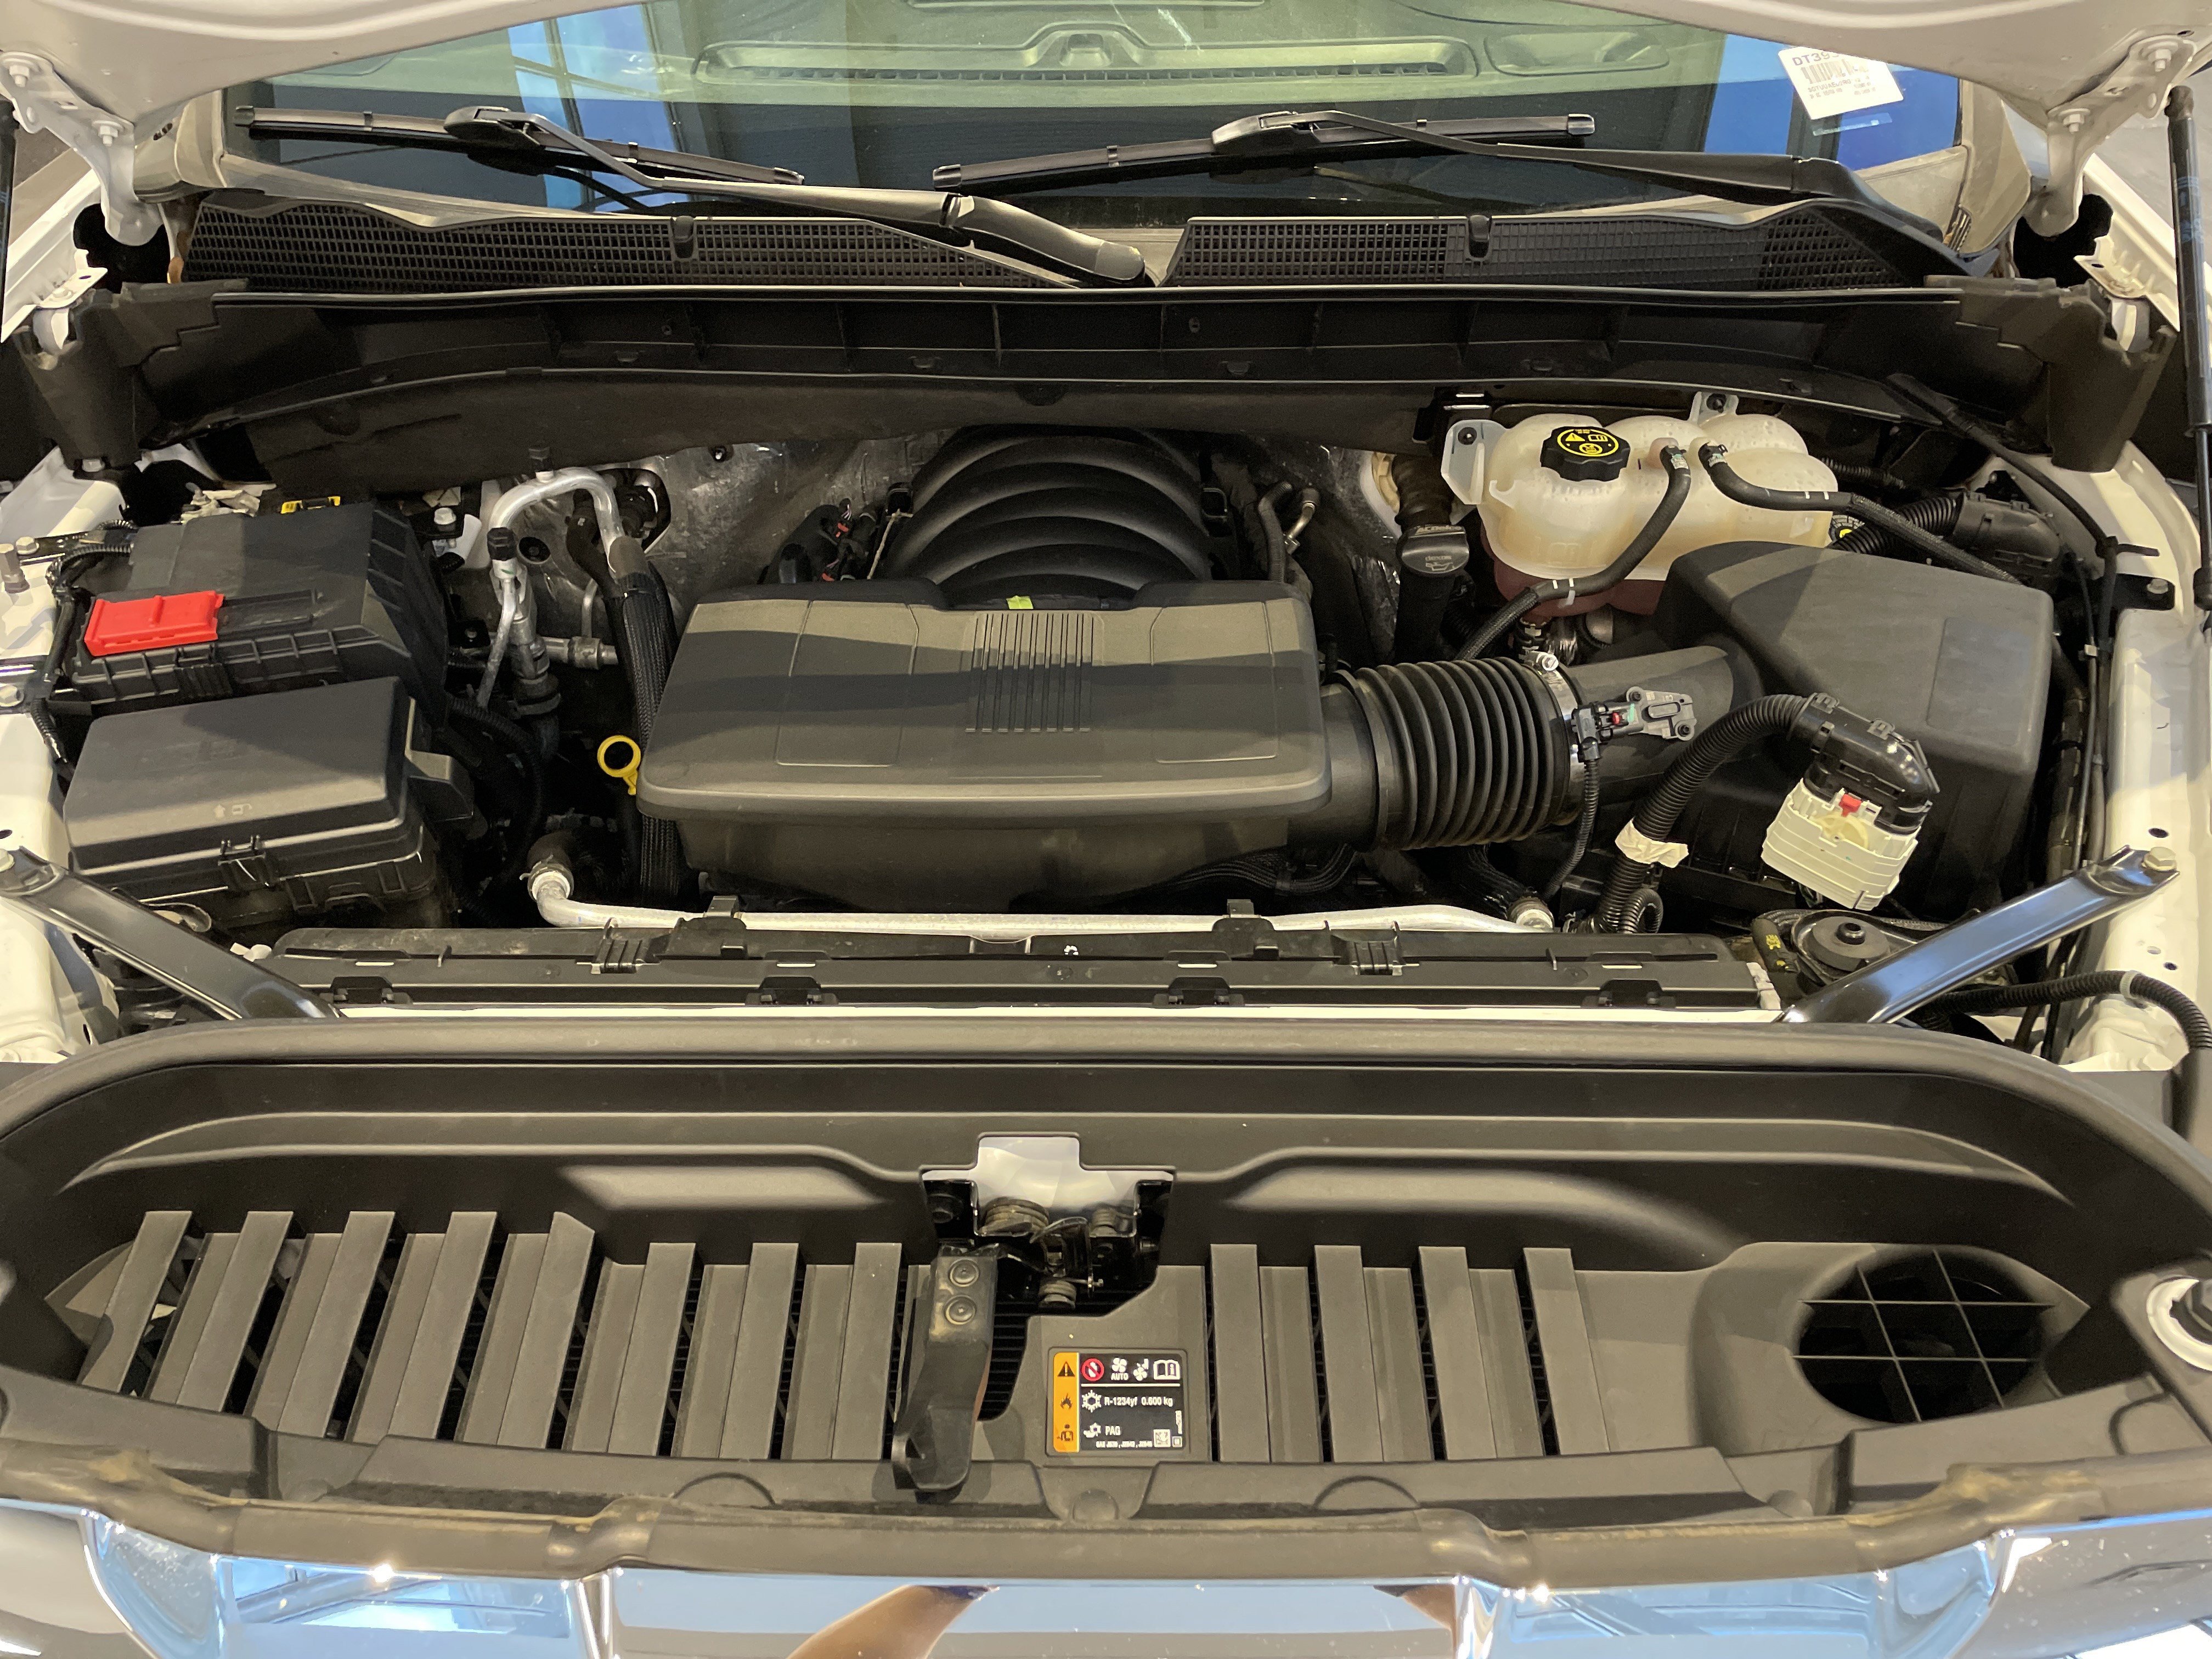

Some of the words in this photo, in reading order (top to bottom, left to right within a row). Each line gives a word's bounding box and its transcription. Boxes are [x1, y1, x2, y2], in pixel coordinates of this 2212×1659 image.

[1792, 52, 1839, 66] DT39
[1104, 1397, 1137, 1408] R-1234yf
[1141, 1397, 1162, 1406] 0.600
[1164, 1397, 1173, 1407] kg
[1105, 1425, 1121, 1436] PAG
